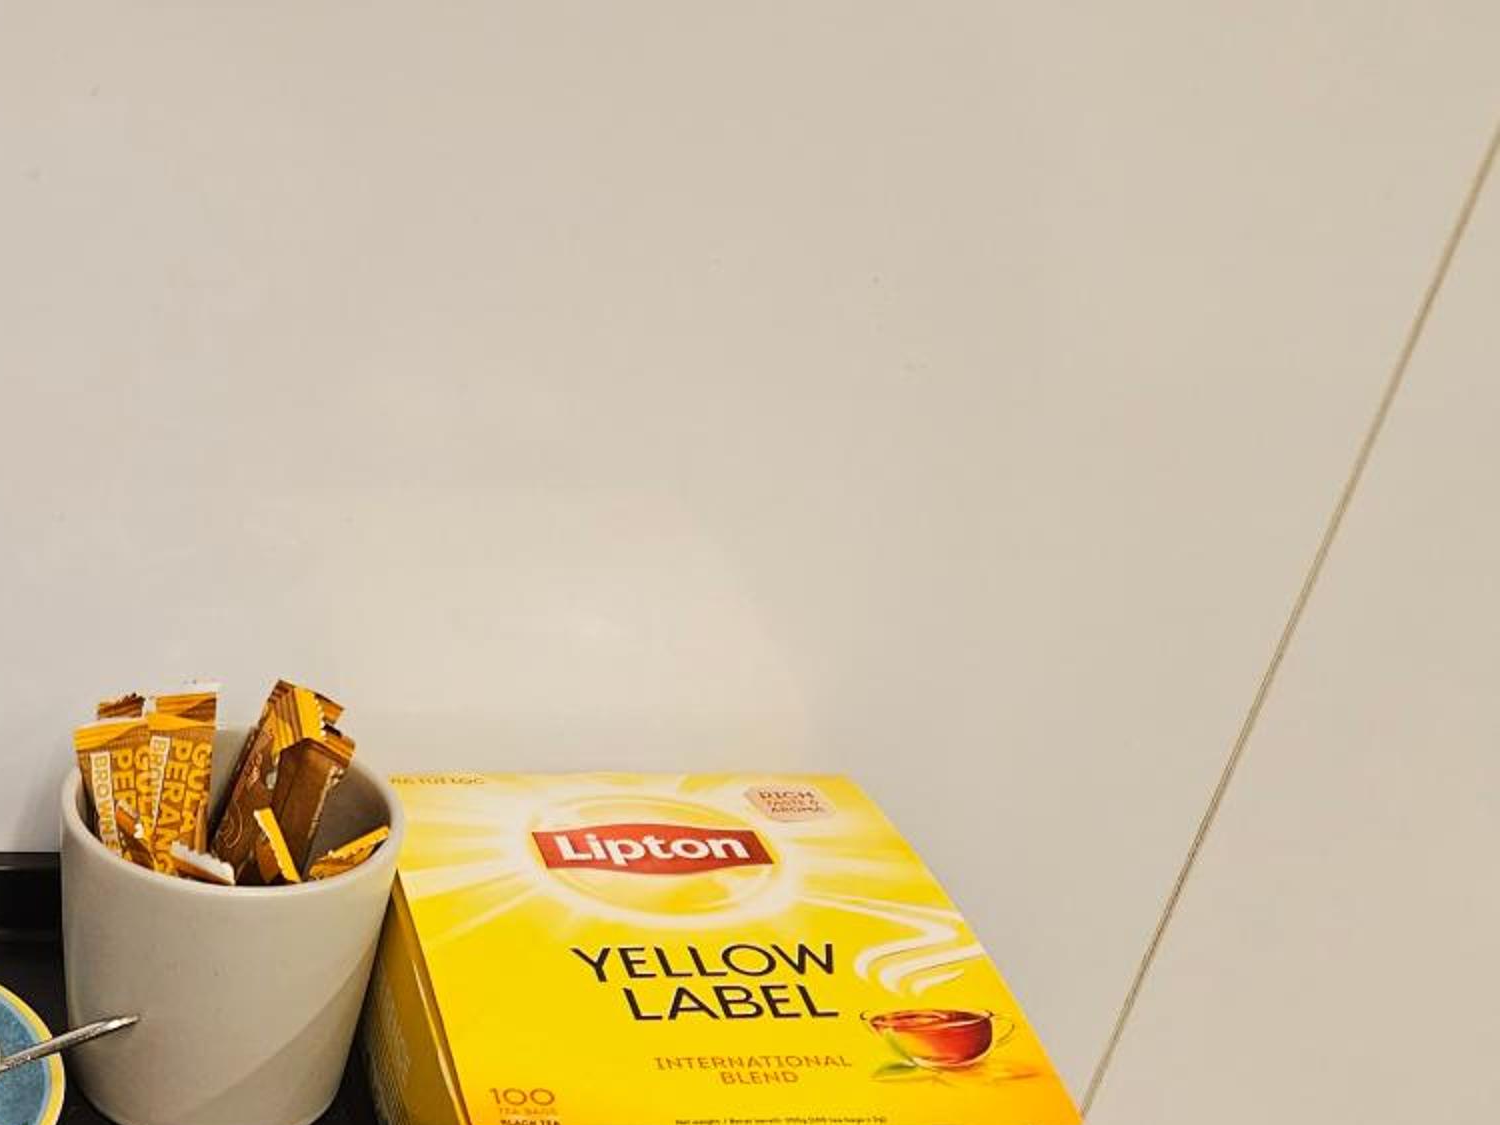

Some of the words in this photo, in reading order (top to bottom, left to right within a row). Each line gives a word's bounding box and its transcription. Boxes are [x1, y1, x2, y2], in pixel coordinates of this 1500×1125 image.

[553, 833, 751, 867] Lipton
[570, 942, 835, 983] YELLOW
[621, 984, 840, 1021] LABEL
[653, 1055, 853, 1071] INTERNATIONAL
[719, 1070, 800, 1085] BLEND
[489, 1087, 555, 1106] 100
